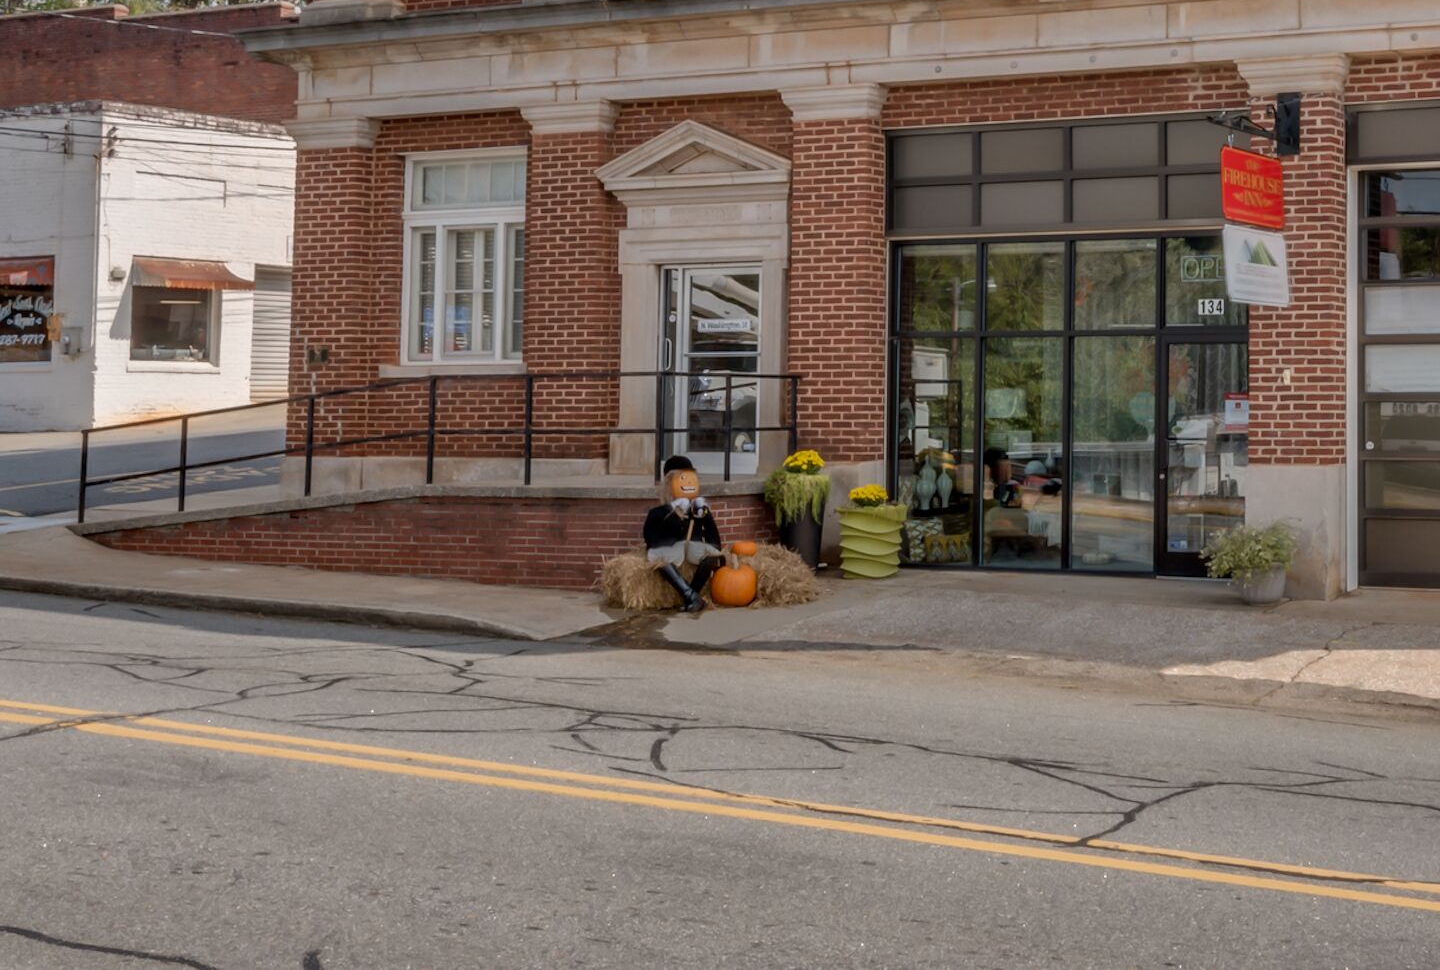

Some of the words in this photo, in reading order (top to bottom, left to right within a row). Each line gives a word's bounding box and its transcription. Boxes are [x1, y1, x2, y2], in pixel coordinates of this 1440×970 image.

[1223, 166, 1281, 195] FIREHOUSE
[1244, 189, 1264, 208] INN
[1184, 257, 1224, 279] OPE
[1201, 300, 1222, 314] 134
